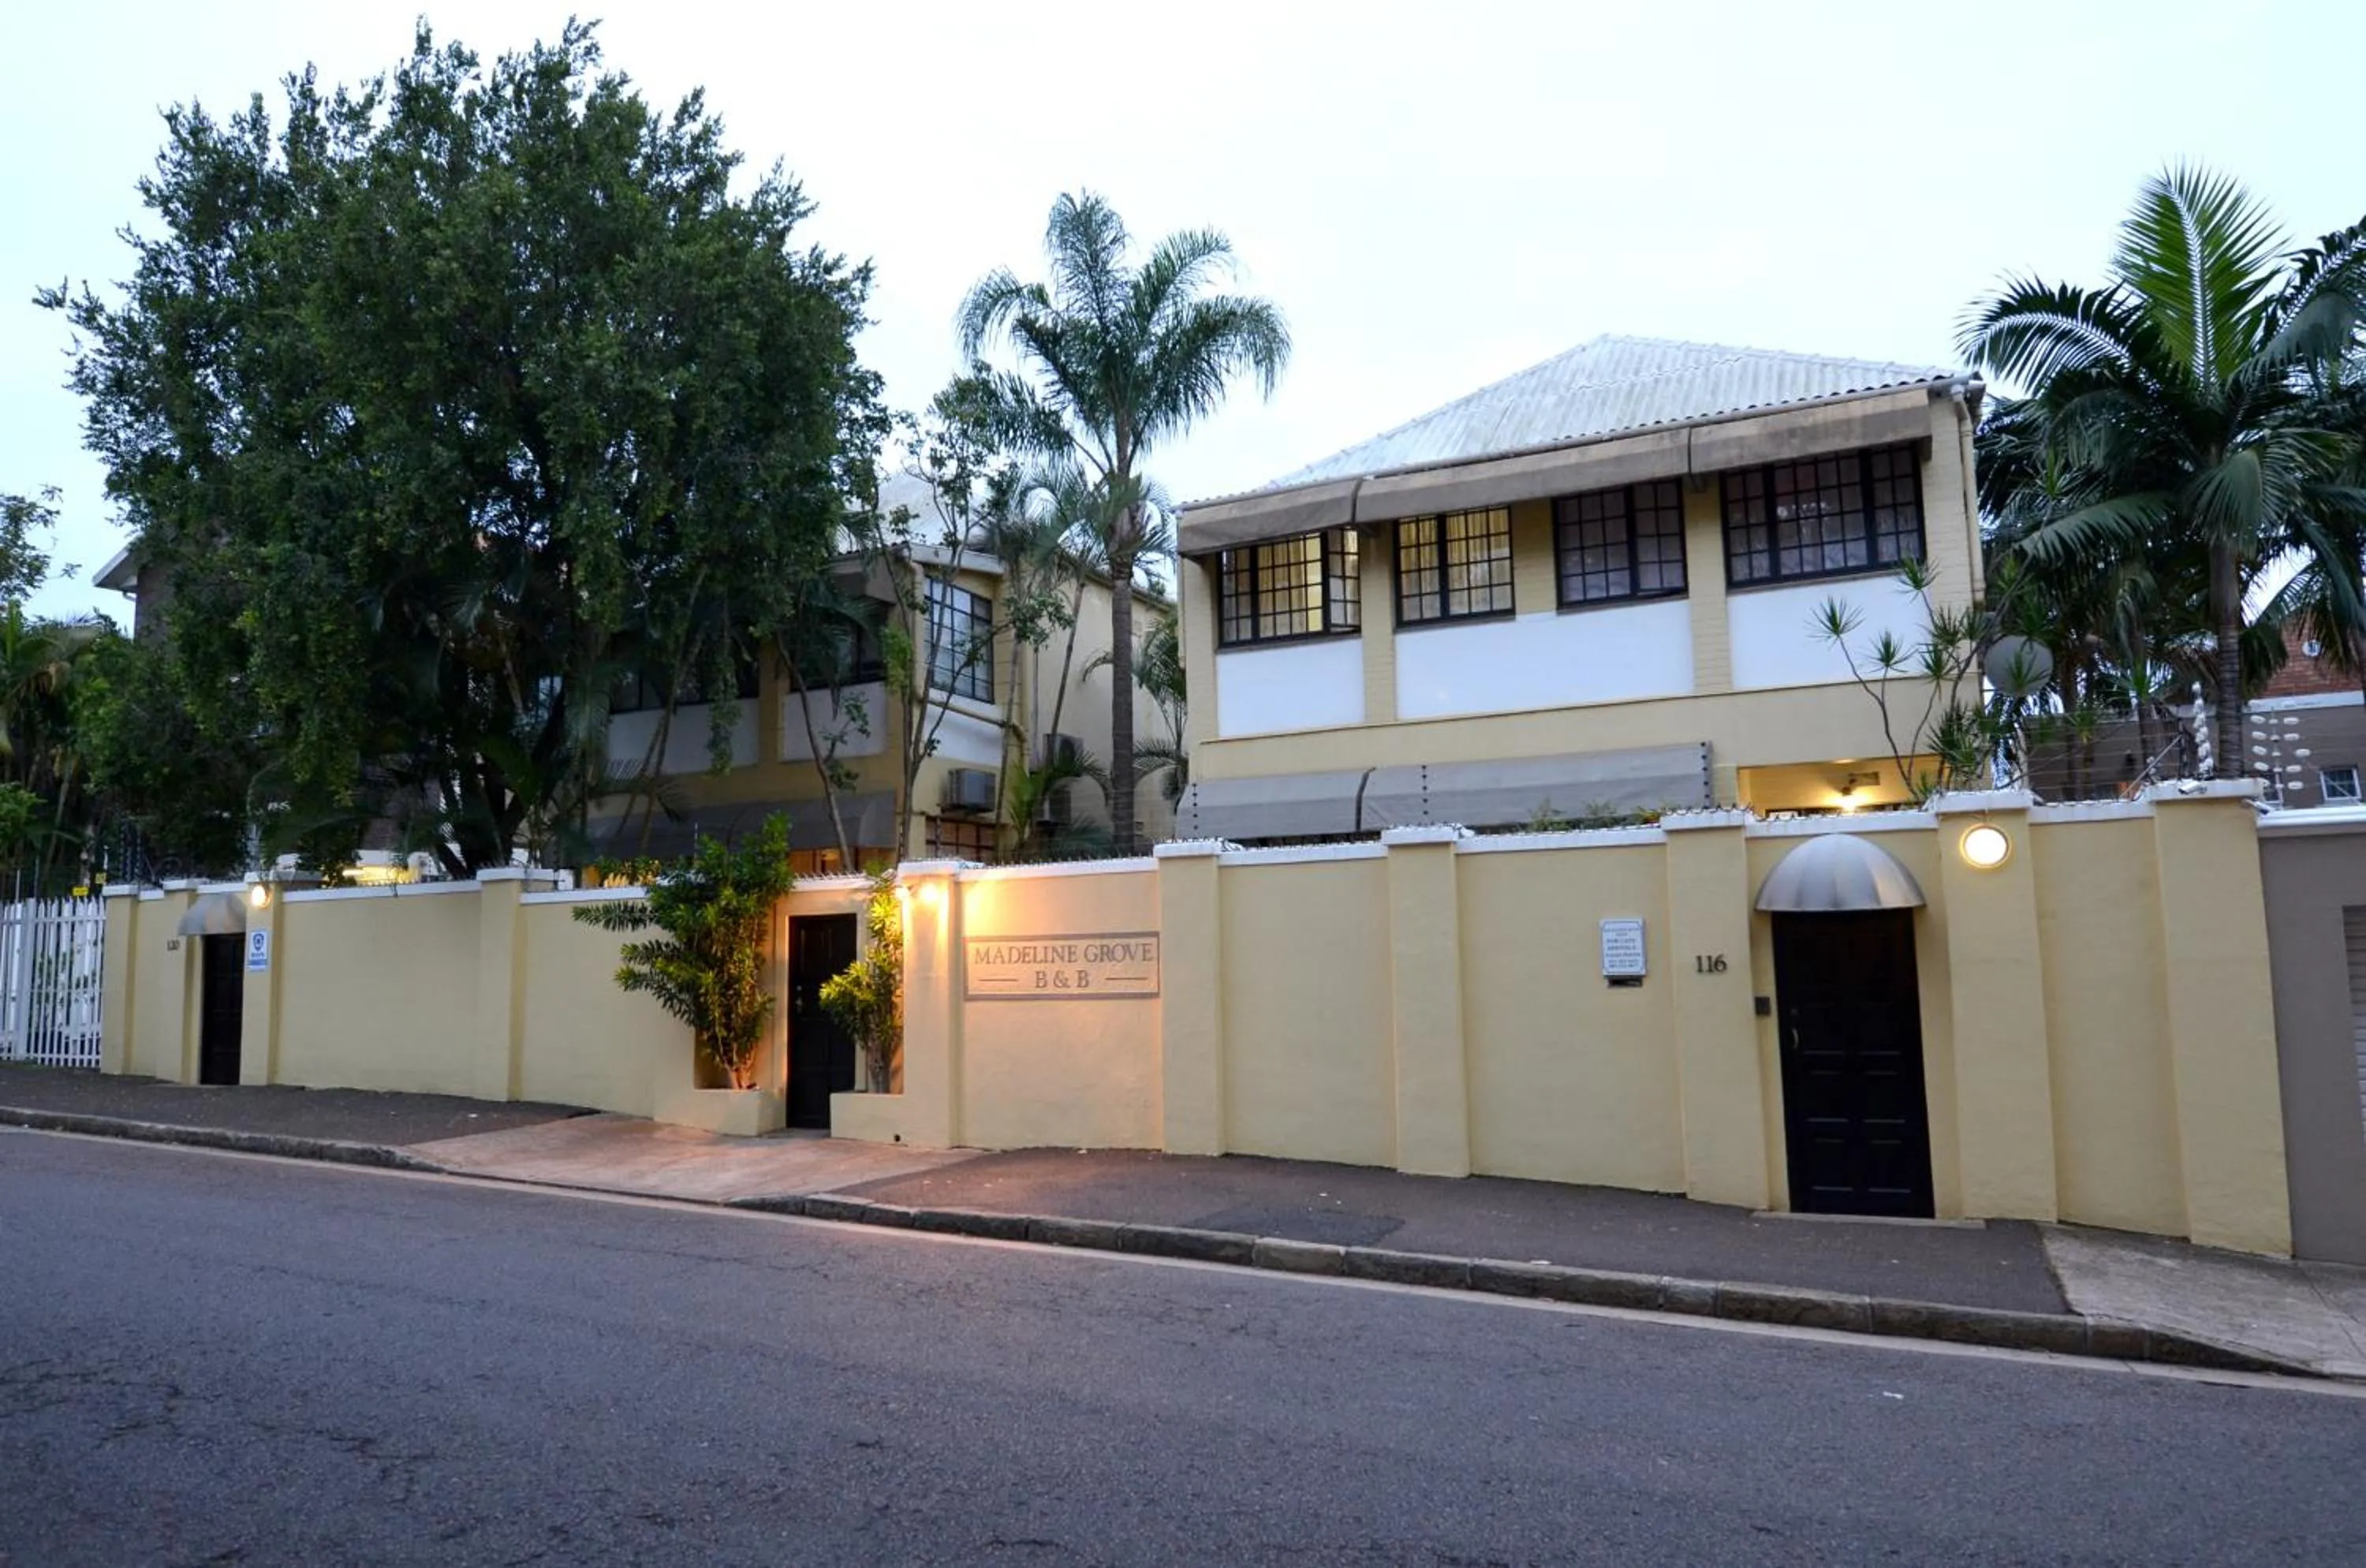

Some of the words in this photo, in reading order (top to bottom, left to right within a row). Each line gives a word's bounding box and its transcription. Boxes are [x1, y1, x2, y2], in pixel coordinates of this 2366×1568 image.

[974, 945, 1078, 965] MADELINE
[1084, 943, 1153, 964] GROVE
[1696, 954, 1727, 973] 116
[1035, 970, 1048, 988] B
[1053, 970, 1071, 988] &
[1076, 970, 1090, 988] B
